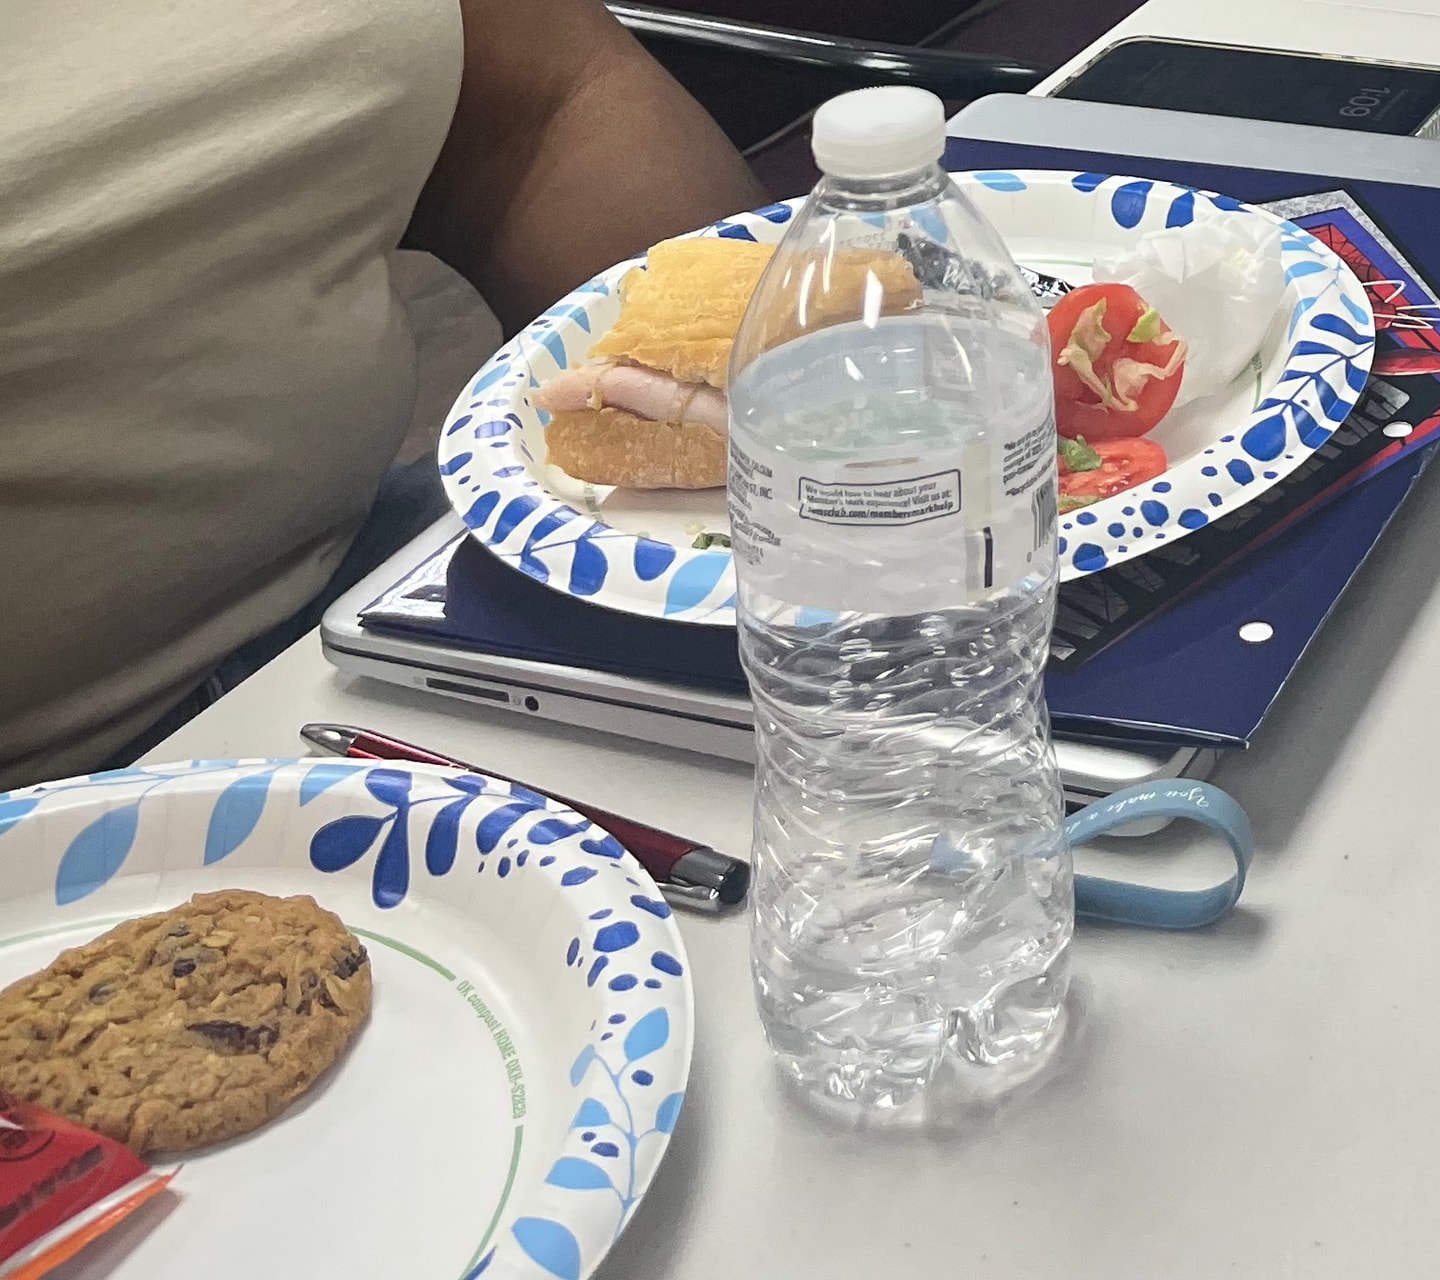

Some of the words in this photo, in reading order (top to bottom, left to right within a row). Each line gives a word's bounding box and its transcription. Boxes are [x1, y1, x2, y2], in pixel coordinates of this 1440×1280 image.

[1339, 87, 1391, 118] 1:09
[893, 486, 917, 498] about
[918, 482, 937, 494] your
[912, 491, 930, 506] Visit
[456, 979, 476, 998] OK
[466, 993, 503, 1033] compost
[492, 1028, 517, 1061] HOME
